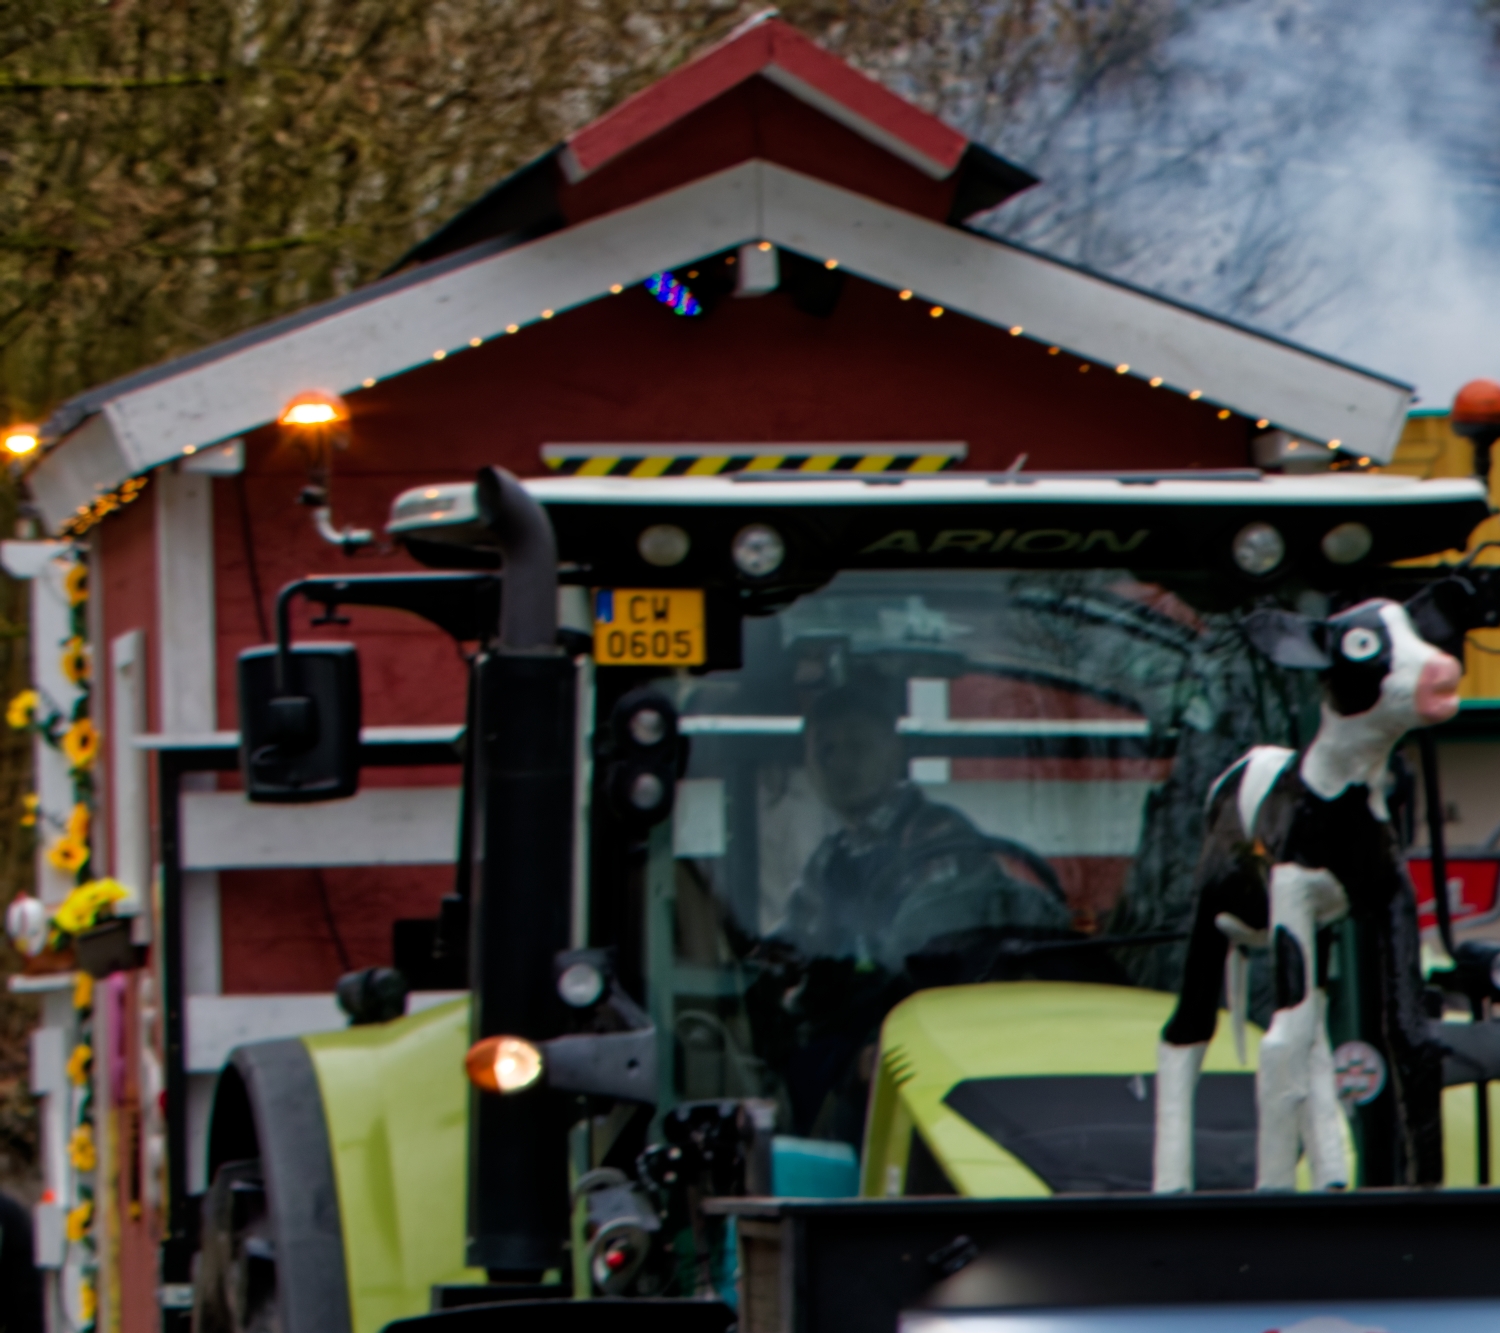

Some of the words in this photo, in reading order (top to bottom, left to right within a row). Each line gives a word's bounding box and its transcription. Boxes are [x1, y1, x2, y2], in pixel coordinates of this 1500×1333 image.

[858, 528, 1151, 553] ARION
[628, 595, 670, 624] CW
[607, 629, 692, 659] 0605
